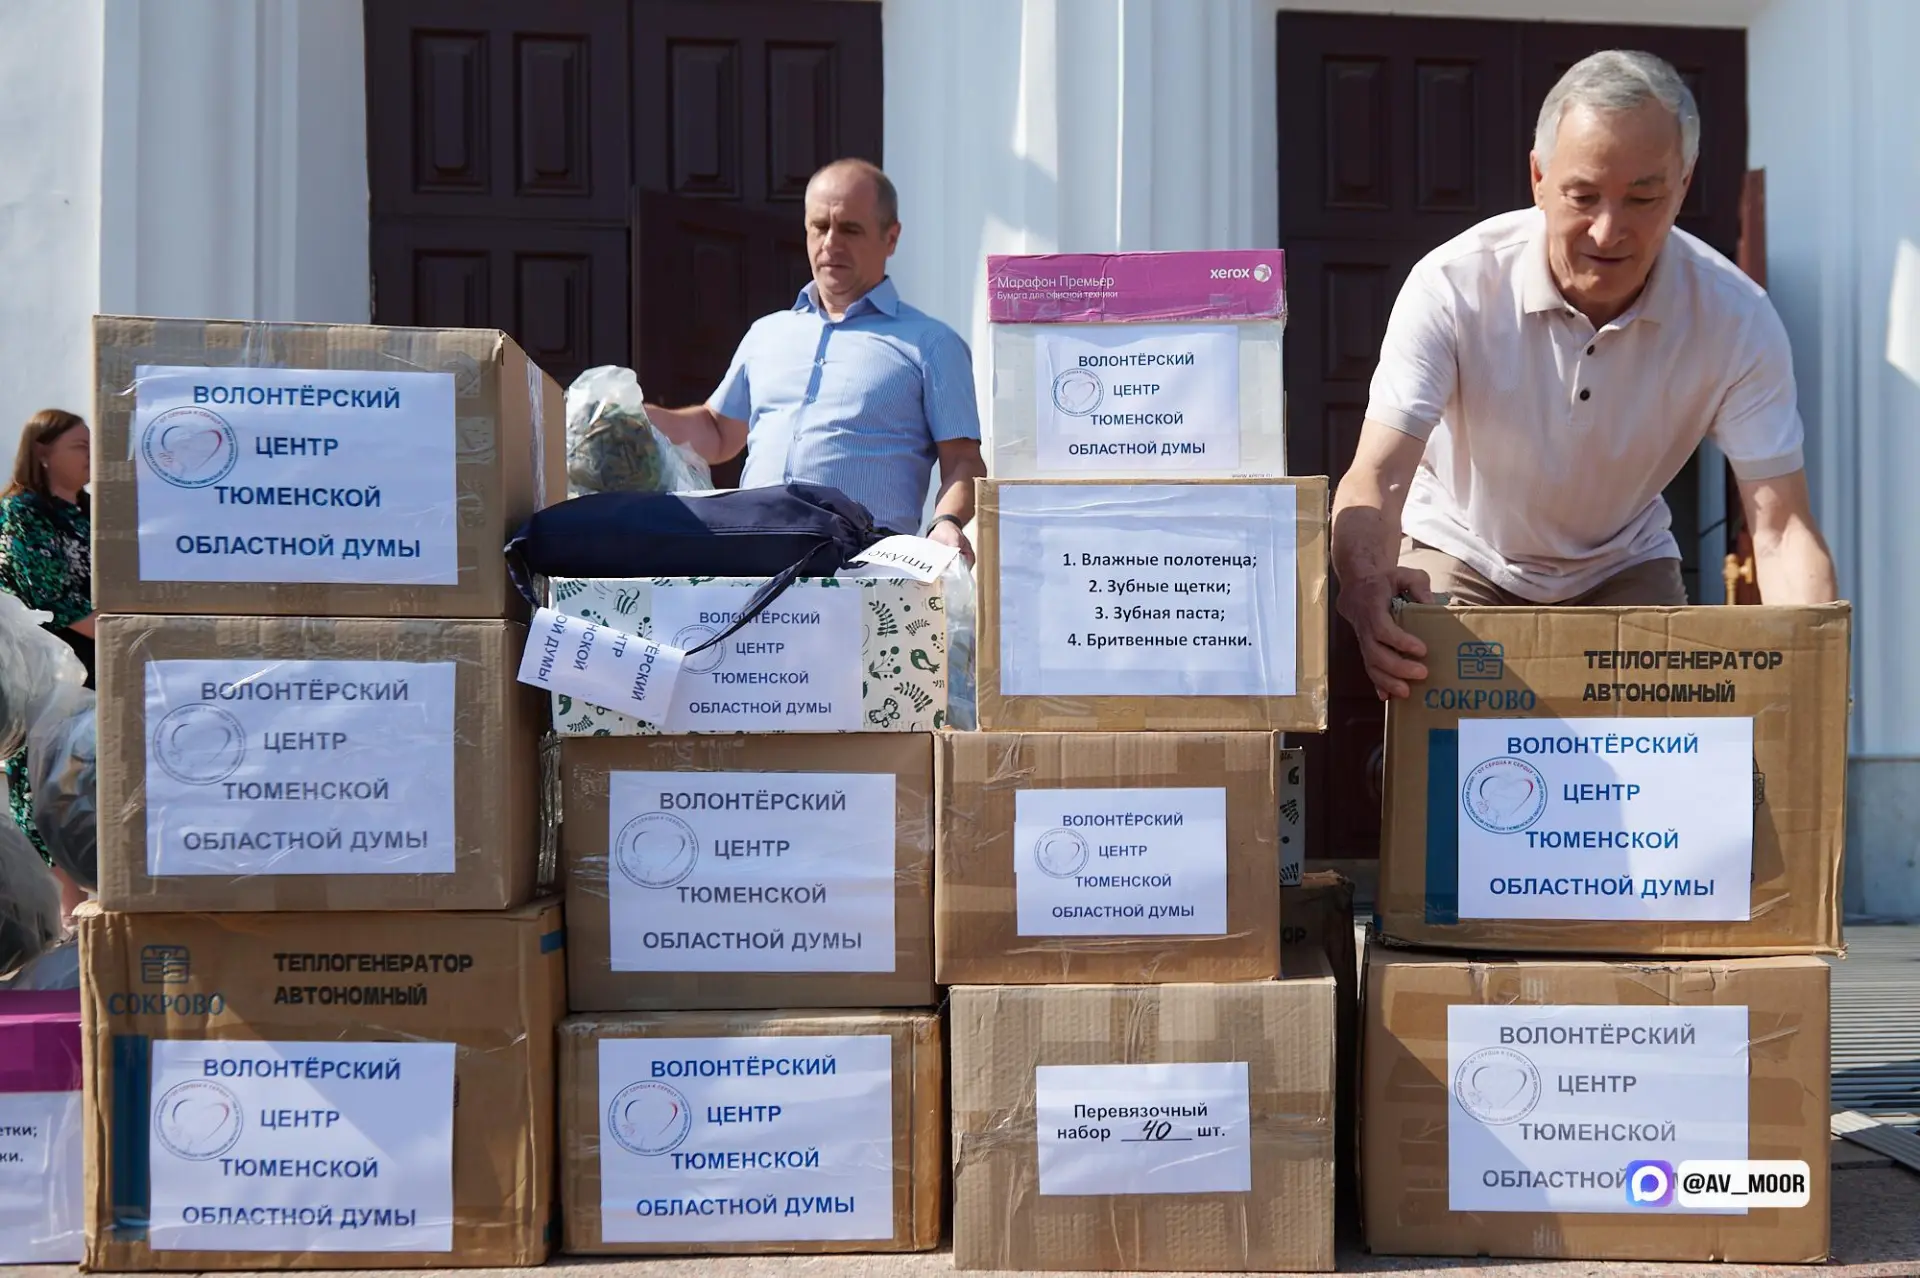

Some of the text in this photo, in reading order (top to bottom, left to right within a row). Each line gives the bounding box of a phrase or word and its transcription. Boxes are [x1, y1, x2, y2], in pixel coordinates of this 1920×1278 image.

[997, 275, 1115, 291] Марафон Премьер
[1210, 267, 1250, 280] xerox
[997, 290, 1118, 301] Бумага для офисной техники
[1079, 353, 1194, 366] ВОЛОНТЁРСКИЙ
[194, 385, 399, 408] ВОЛОНТЁРСКИЙ
[1114, 384, 1159, 397] ЦЕНТР
[1091, 411, 1183, 425] ТЮМЕНСКОЙ
[256, 437, 338, 458] ЦЕНТР
[1069, 441, 1205, 456] ОБЛАСТНОЙ ДУМЫ
[214, 486, 380, 507] ТЮМЕНСКОЙ
[176, 534, 420, 560] ОБЛАСТНОЙ ДУМЫ
[1063, 553, 1256, 568] 1. Влажные полотенца;
[1089, 579, 1230, 595] 2. Зубные щетки;
[1095, 606, 1224, 622] 3. Зубная паста;
[538, 614, 568, 682] ОЙ ДУМЫ
[573, 624, 599, 671] НСКОЙ
[612, 633, 629, 658] НТР
[736, 643, 784, 655] ЦЕНТР
[1068, 633, 1251, 649] 4. Бритвенные станки.
[1584, 650, 1782, 673] ТЕПЛОГЕНЕРАТОР
[712, 670, 808, 683] ТЮМЕНСКОЙ
[202, 679, 408, 700] ВОЛОНТЁРСКИЙ
[1583, 680, 1735, 702] АВТОНОМНЫЙ
[690, 702, 831, 715] ОБЛАСТНОЙ ДУМЫ
[1425, 689, 1536, 711] СОКРОВО
[264, 732, 347, 753] ЦЕНТР
[1508, 733, 1698, 754] ВОЛОНТЁРСКИЙ
[223, 778, 389, 800] ТЮМЕНСКОЙ
[1564, 784, 1640, 804] ЦЕНТР
[661, 790, 845, 810] ВОЛОНТЁРСКИЙ
[1063, 813, 1183, 826] ВОЛОНТЁРСКИЙ
[184, 828, 427, 852] ОБЛАСТНОЙ ДУМЫ
[1525, 829, 1678, 848] ТЮМЕНСКОЙ
[715, 840, 790, 860] ЦЕНТР
[1099, 846, 1147, 858] ЦЕНТР
[1075, 873, 1171, 887] ТЮМЕНСКОЙ
[1490, 875, 1714, 899] ОБЛАСТНОЙ ДУМЫ
[677, 883, 825, 903] ТЮМЕНСКОЙ
[1052, 906, 1193, 919] ОБЛАСТНОЙ ДУМЫ
[643, 929, 861, 952] ОБЛАСТНОЙ ДУМЫ
[274, 953, 473, 973] ТЕПЛОГЕНЕРАТОР
[108, 993, 224, 1016] СОКРОВО
[274, 986, 427, 1005] АВТОНОМНЫЙ
[1501, 1024, 1694, 1044] ВОЛОНТЁРСКИЙ
[204, 1057, 400, 1080] ВОЛОНТЁРСКИЙ
[652, 1055, 835, 1077] ВОЛОНТЁРСКИЙ
[1559, 1075, 1636, 1096] ЦЕНТР
[261, 1110, 339, 1130] ЦЕНТР
[708, 1106, 781, 1126] ЦЕНТР
[1075, 1103, 1207, 1121] Перевязочный
[1058, 1120, 1225, 1142] набор 40 шт.
[1519, 1121, 1675, 1141] ТЮМЕНСКОЙ
[219, 1155, 377, 1177] ТЮМЕНСКОЙ
[671, 1149, 818, 1169] ТЮМЕНСКОЙ
[637, 1194, 854, 1216] ОБЛАСТНОЙ ДУМЫ
[183, 1205, 415, 1229] ОБЛАСТНОЙ ДУМЫ
